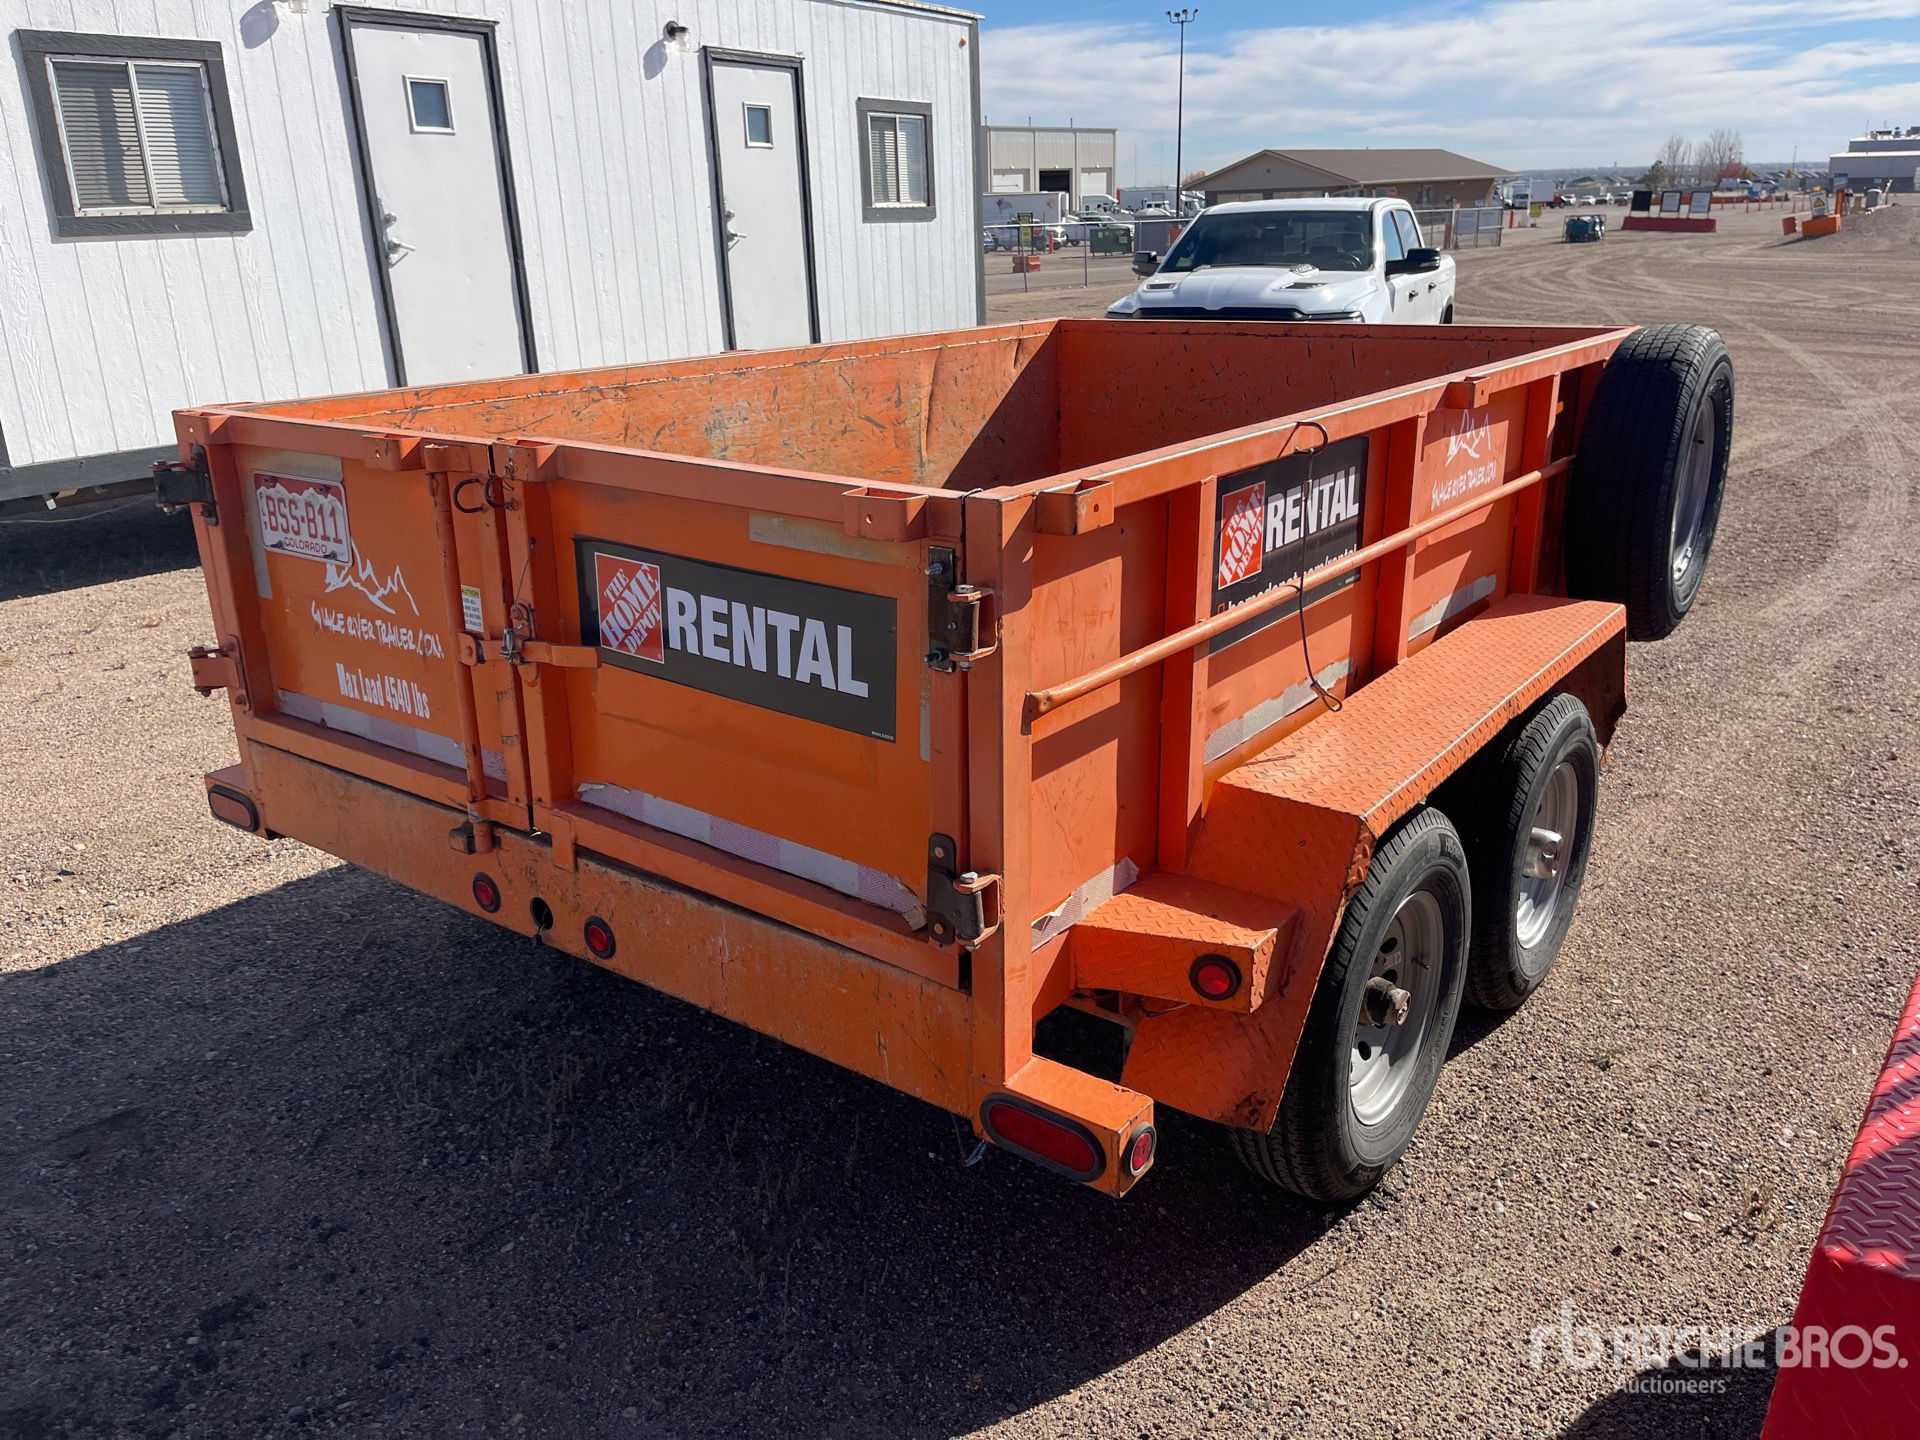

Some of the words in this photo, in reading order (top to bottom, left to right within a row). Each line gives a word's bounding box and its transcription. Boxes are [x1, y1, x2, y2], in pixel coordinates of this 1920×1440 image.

[1219, 484, 1264, 584] HOME
[1226, 499, 1246, 540] THE
[1265, 466, 1359, 553] RENTAL
[283, 536, 328, 554] COLORADO
[1236, 516, 1264, 579] DEPOT
[600, 563, 660, 650] HOME
[603, 568, 629, 604] THE
[624, 601, 661, 654] DEPOT
[666, 586, 869, 698] RENTAL
[336, 662, 360, 700] Max
[358, 668, 385, 707] Load
[384, 675, 412, 714] 4540
[410, 682, 430, 719] lbs
